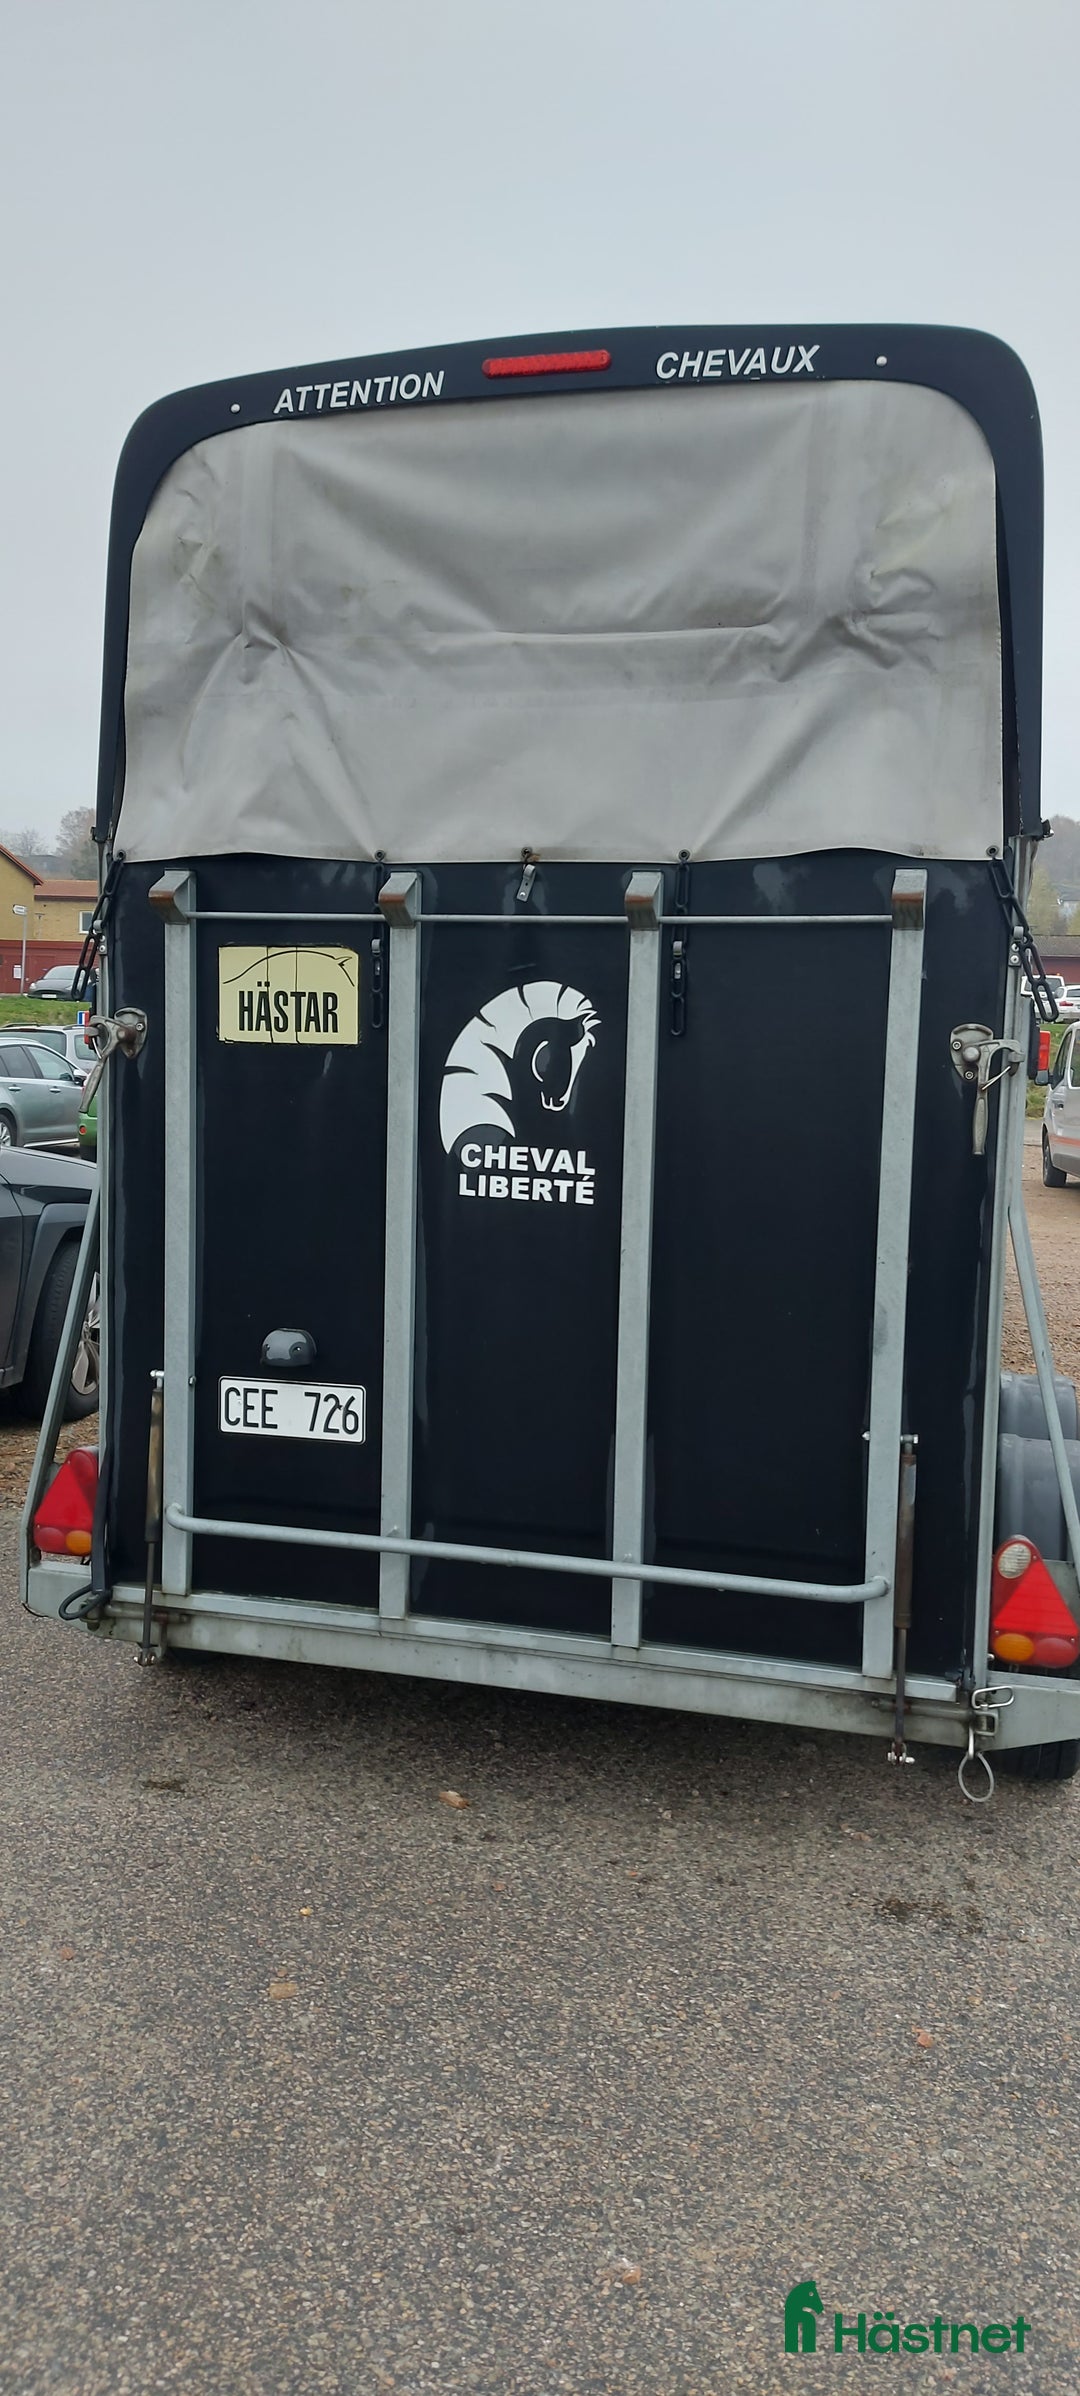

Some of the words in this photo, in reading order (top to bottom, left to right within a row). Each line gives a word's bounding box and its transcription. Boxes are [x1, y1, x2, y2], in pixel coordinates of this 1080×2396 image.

[273, 371, 444, 414] ATTENTION
[655, 345, 820, 381] CHEVAUX
[237, 980, 339, 1034] HÄSTAR
[460, 1143, 595, 1175] CHEVAL
[458, 1173, 595, 1205] LIBERTÉ
[224, 1386, 278, 1429] CEE
[304, 1391, 359, 1435] 726
